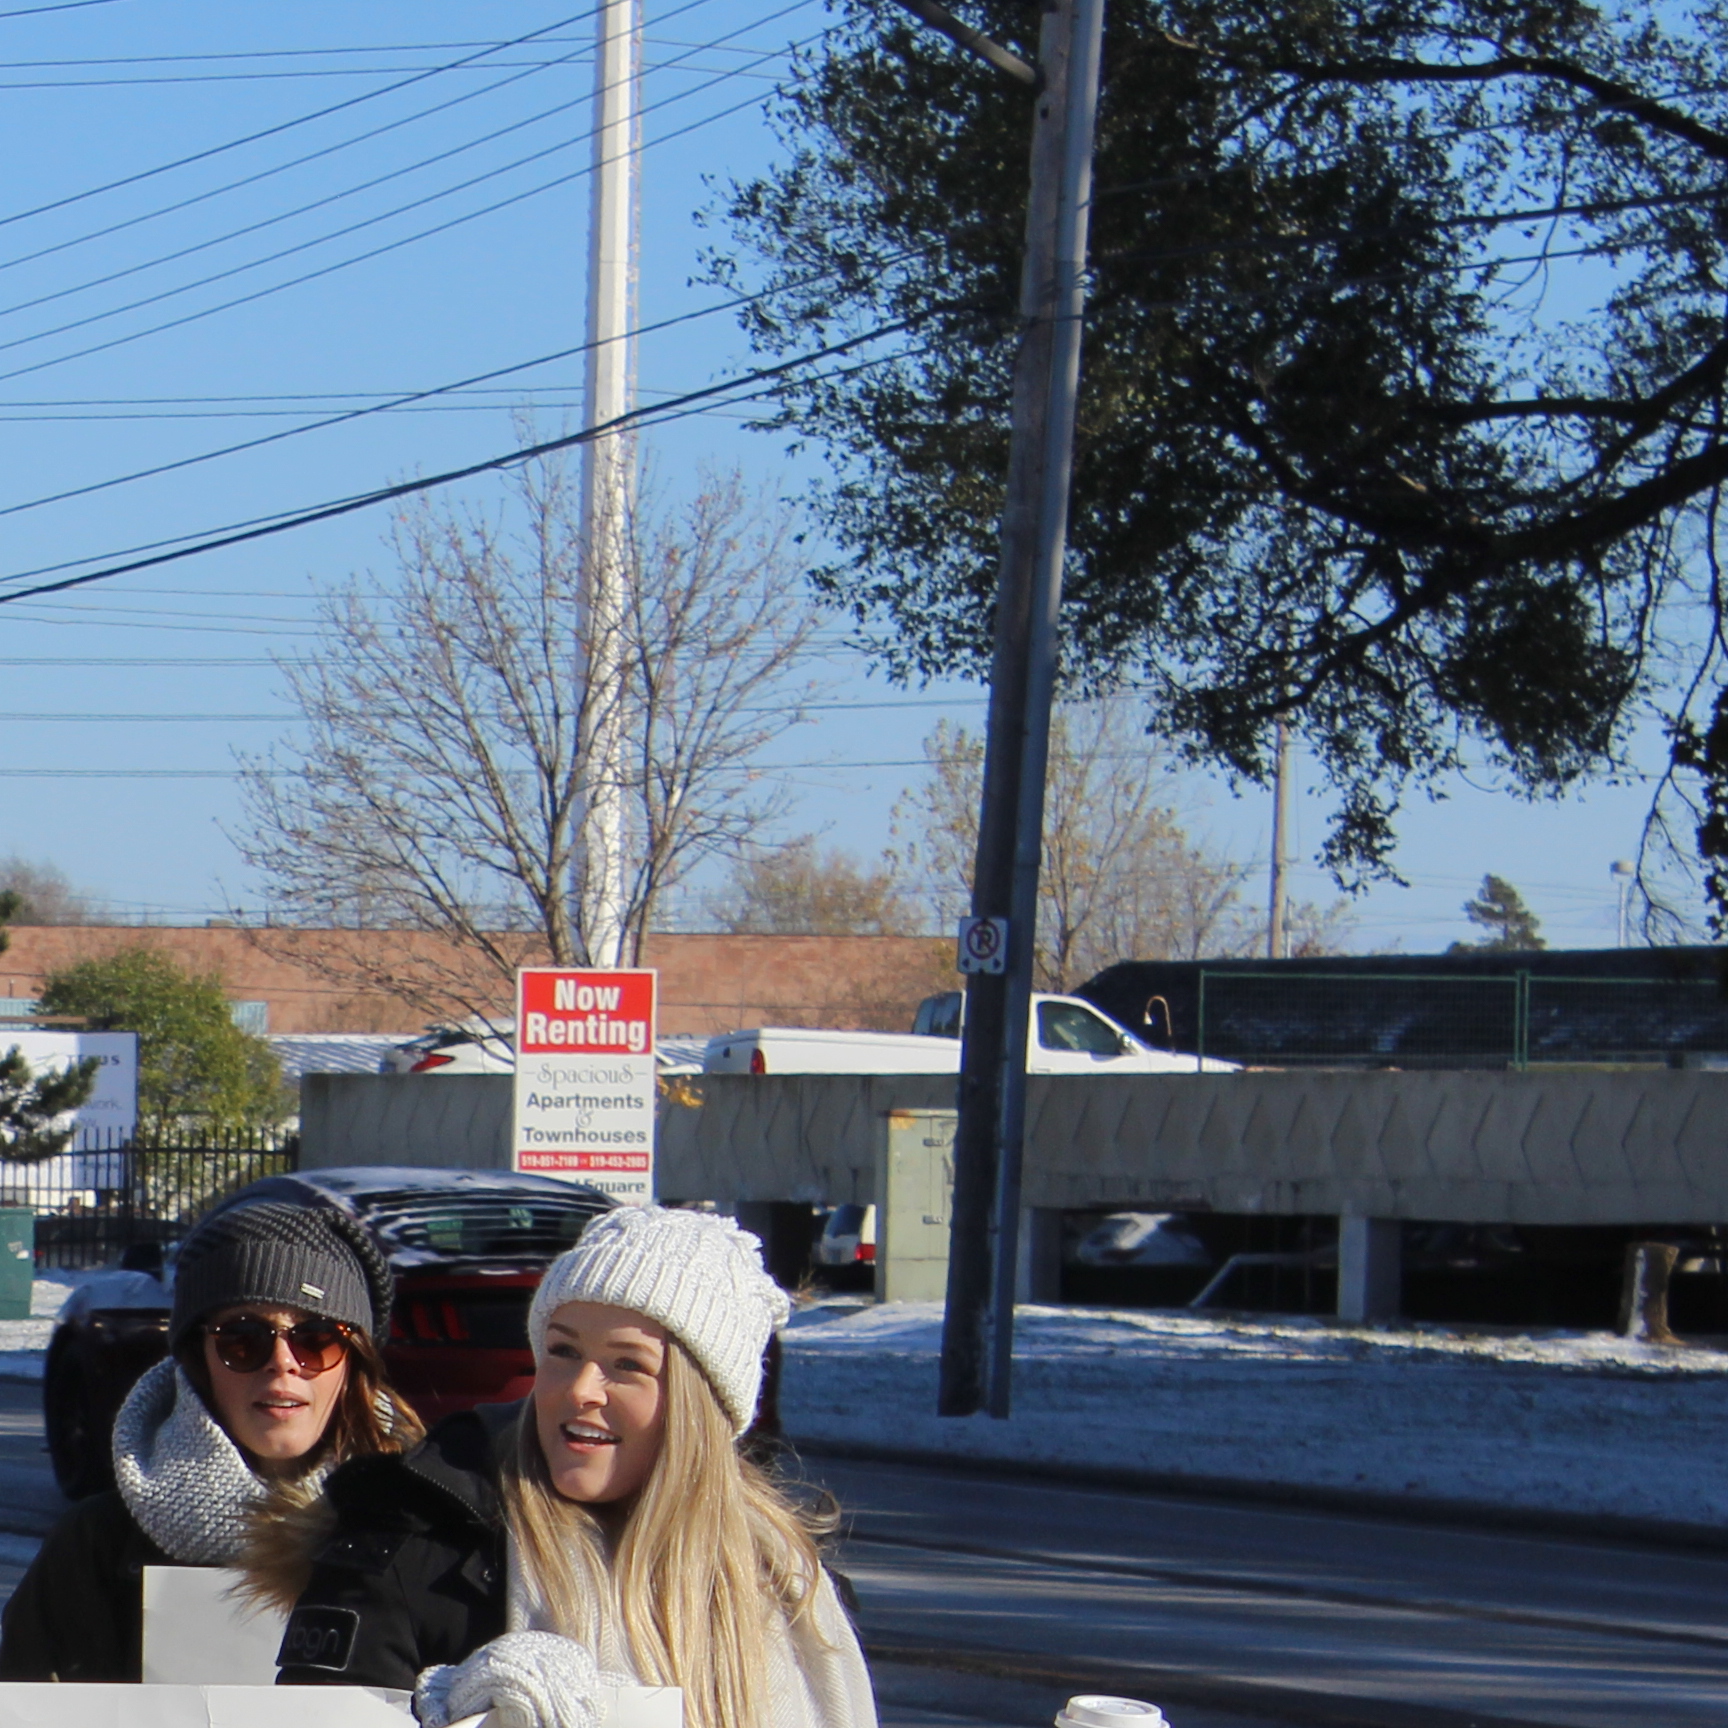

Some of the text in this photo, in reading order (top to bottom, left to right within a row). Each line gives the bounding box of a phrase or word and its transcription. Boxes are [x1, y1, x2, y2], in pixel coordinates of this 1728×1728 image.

[553, 978, 621, 1012] Now
[526, 1011, 646, 1052] Renting
[526, 1092, 644, 1111] Apartments
[522, 1127, 647, 1143] Townhouses
